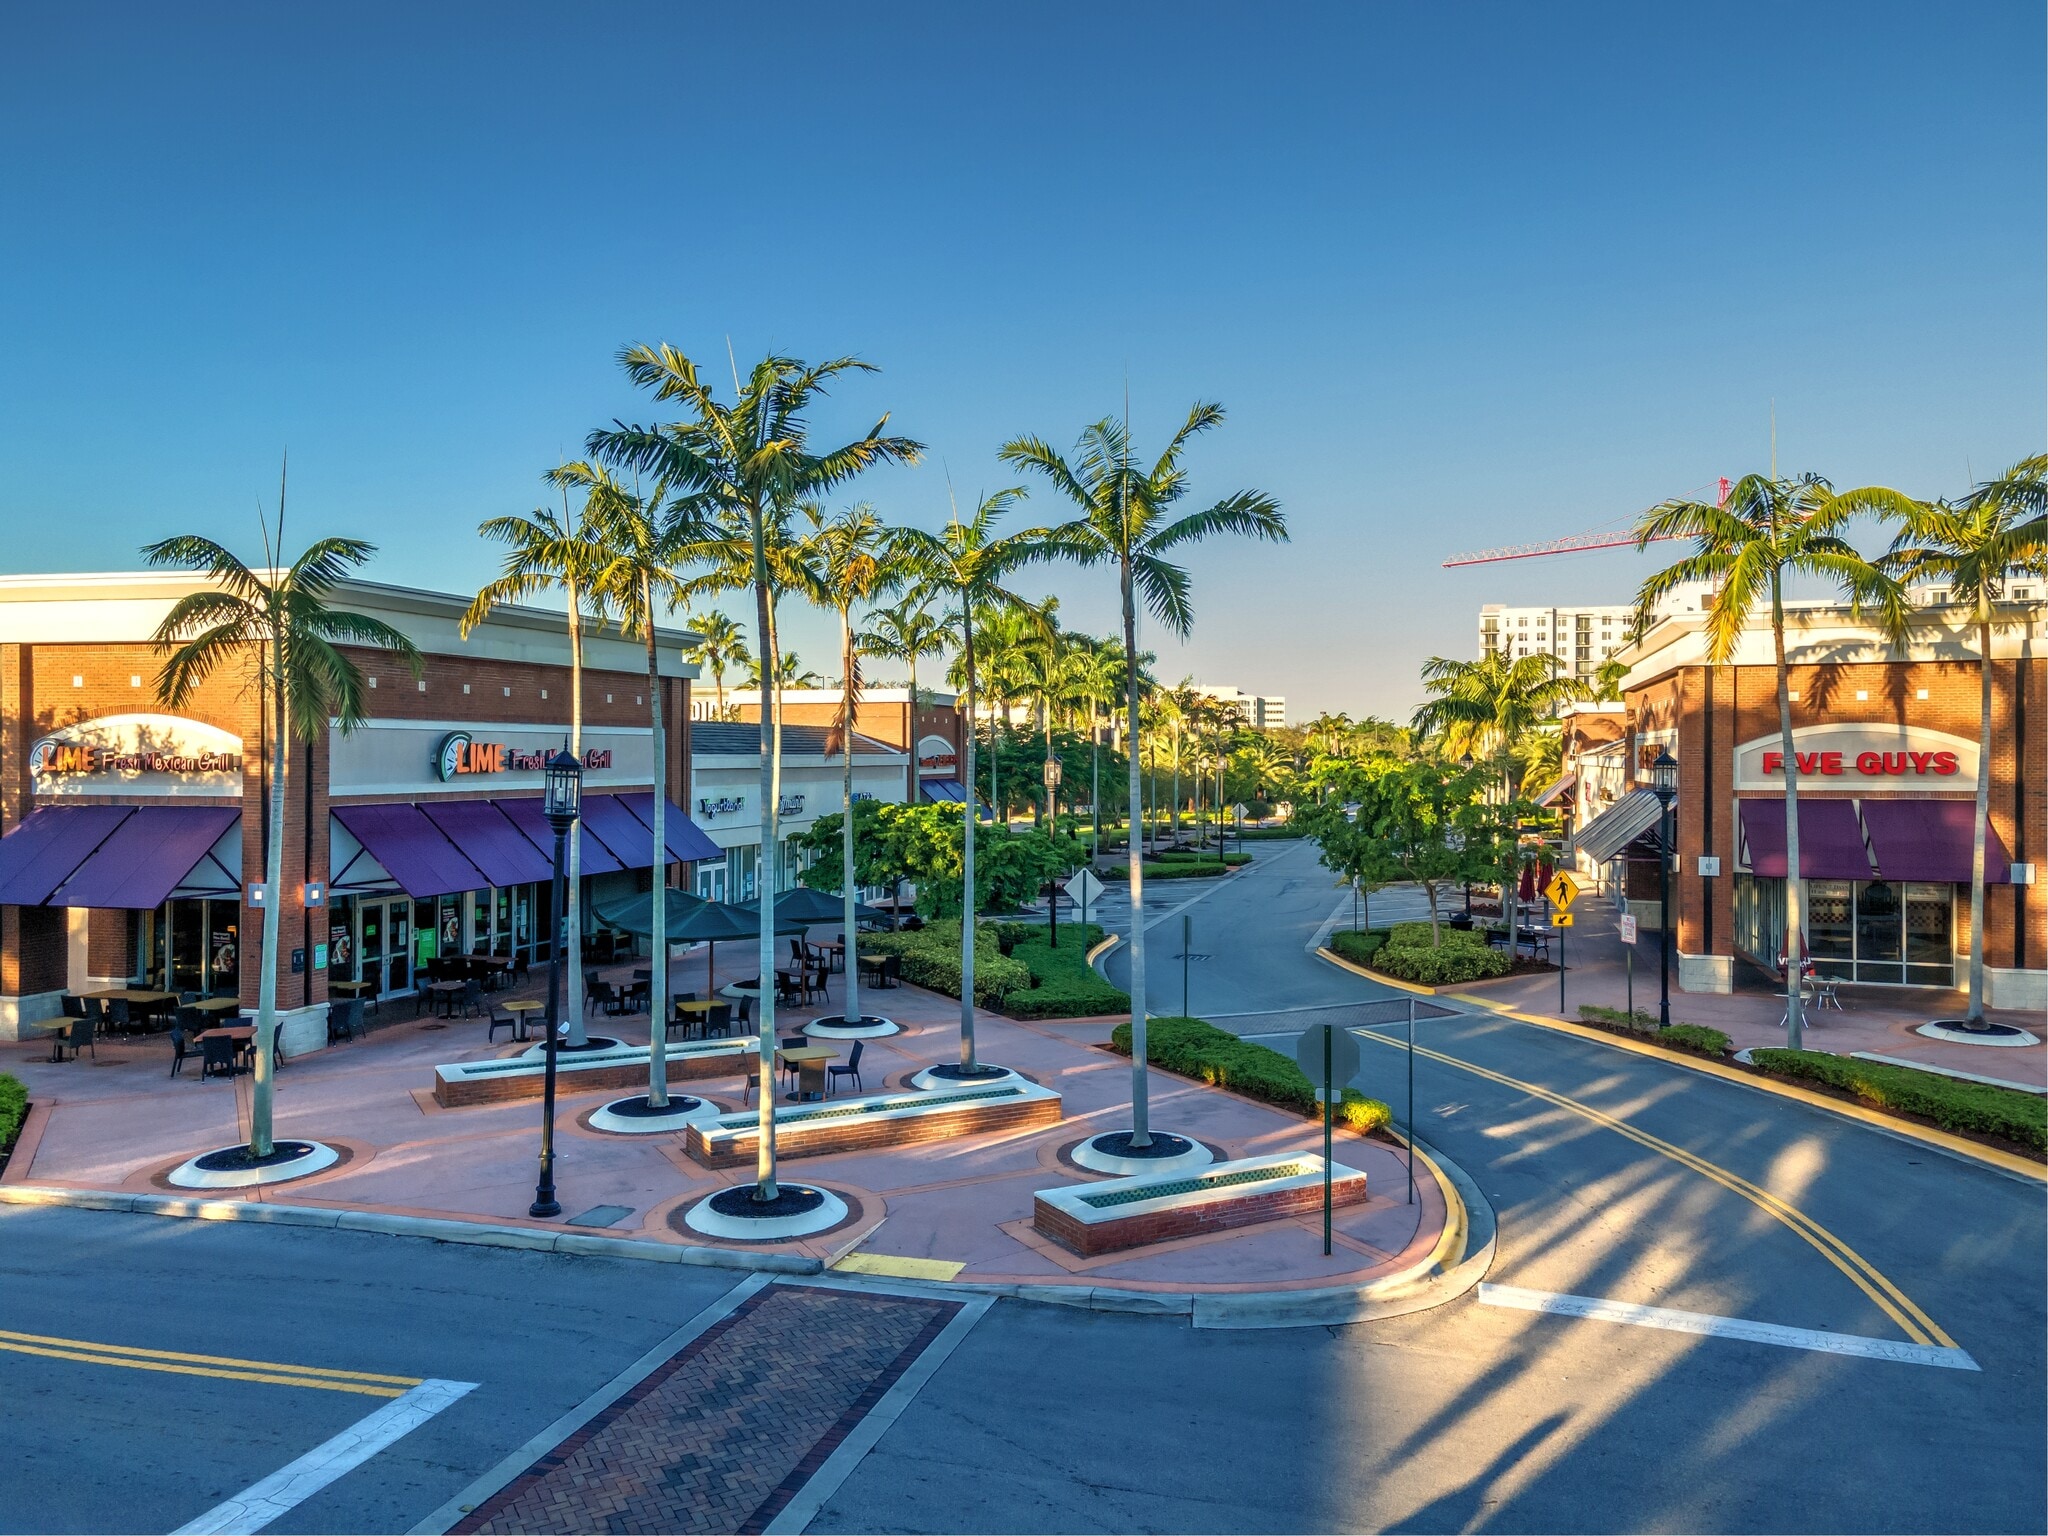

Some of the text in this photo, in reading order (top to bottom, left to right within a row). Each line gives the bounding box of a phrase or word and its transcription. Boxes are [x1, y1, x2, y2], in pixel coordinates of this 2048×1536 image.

[42, 746, 229, 772] LIME Fresh Mexican Grill
[456, 742, 506, 774] LIME
[511, 749, 546, 770] Fresh
[589, 748, 613, 770] Grill
[1763, 751, 1958, 776] FVE GUYS
